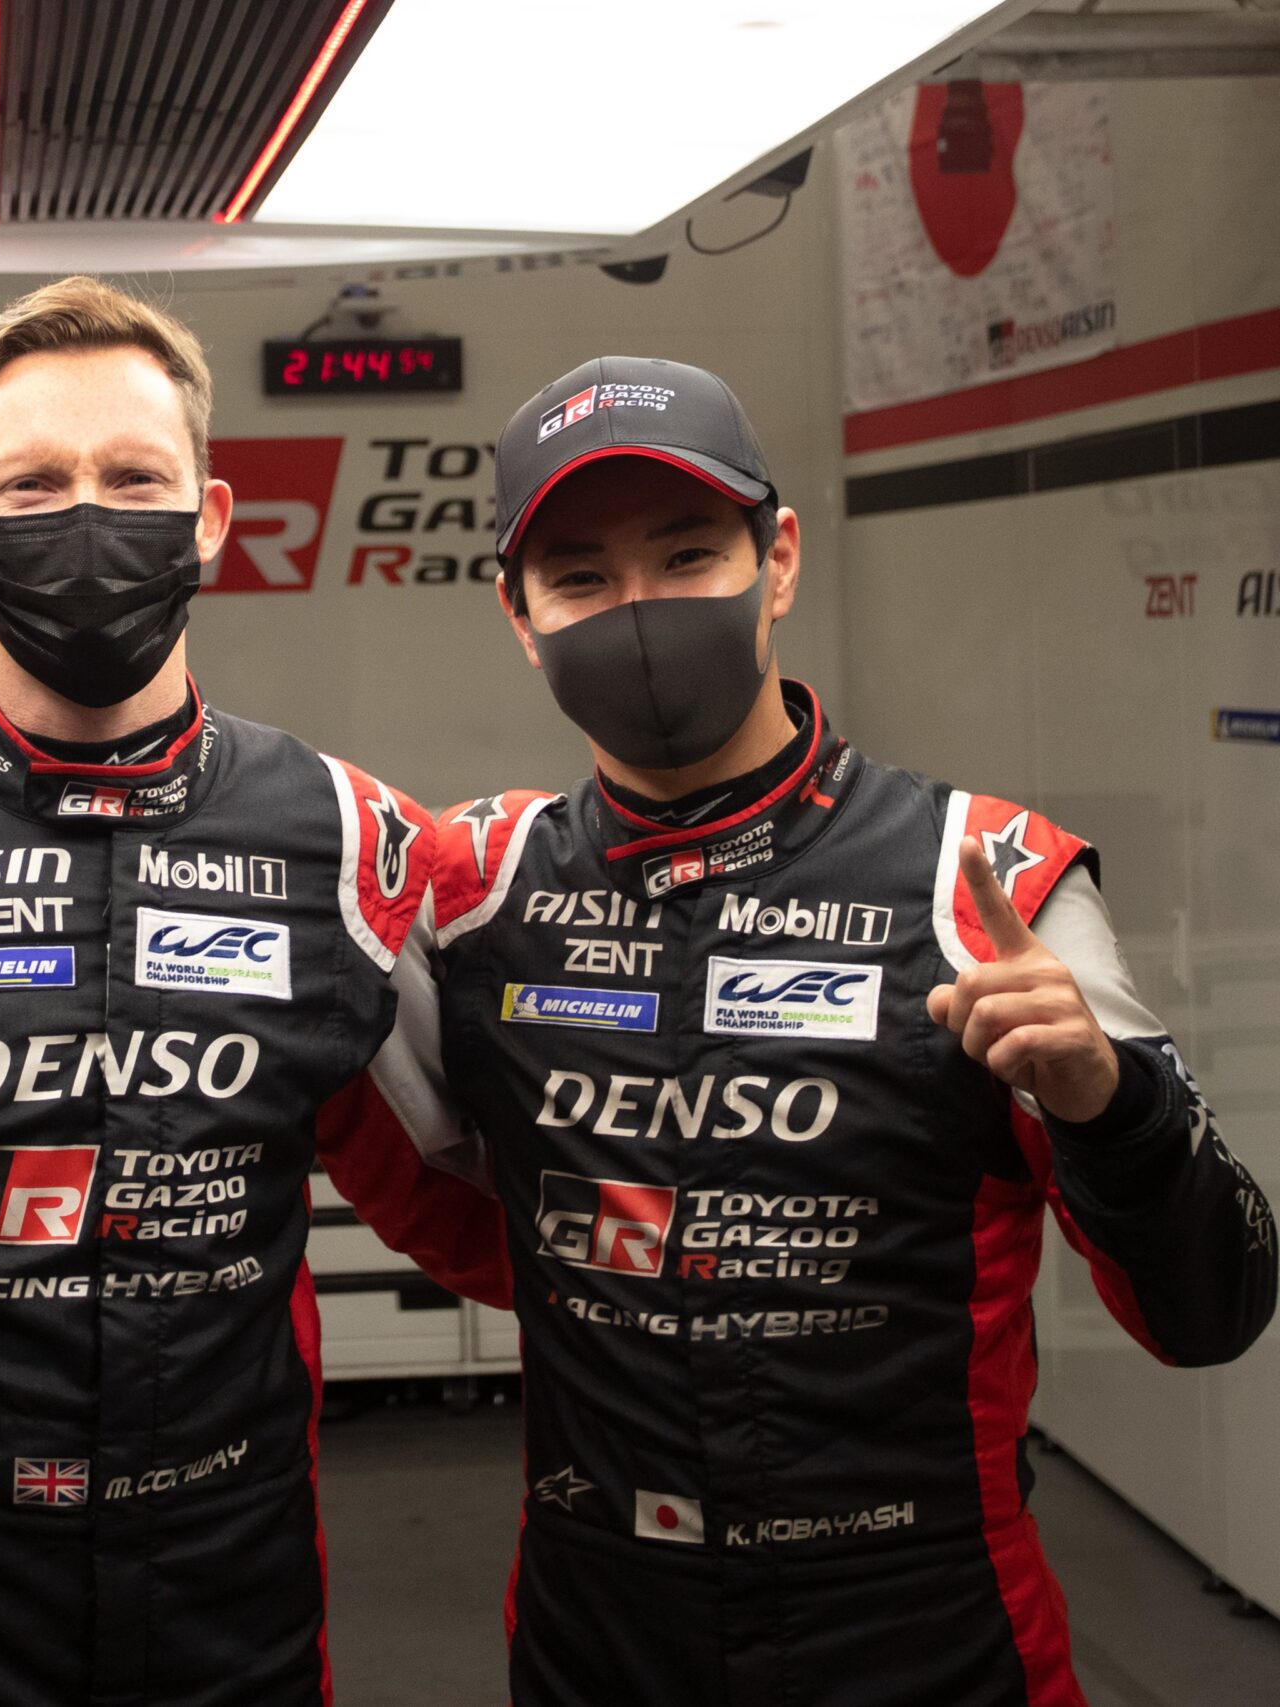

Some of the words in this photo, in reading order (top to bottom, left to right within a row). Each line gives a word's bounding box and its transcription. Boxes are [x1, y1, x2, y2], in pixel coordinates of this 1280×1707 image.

[598, 399, 667, 411] Racing
[601, 383, 675, 397] TOYOTA
[539, 399, 590, 438] GR
[600, 391, 668, 402] GAZOO
[358, 493, 497, 533] GA
[346, 545, 499, 585] Rac
[1144, 572, 1198, 618] ZENT
[1237, 570, 1280, 618] AI
[136, 774, 188, 798] TOYOTA
[129, 801, 186, 816] Racing
[706, 820, 774, 854] TOYOTA
[137, 844, 244, 894] Mobil
[648, 861, 701, 895] GR
[709, 835, 772, 865] GAZOO
[709, 848, 774, 875] Racing
[718, 893, 841, 941] Mobil
[148, 925, 280, 963] WEC
[564, 938, 663, 977] ZENT
[146, 961, 163, 972] FIA
[166, 963, 205, 974] WORLD
[207, 967, 273, 980] ENDURANCE
[146, 971, 229, 986] CHAMPIONSHIP
[718, 970, 870, 1006] WEC
[541, 998, 642, 1019] MICHELIN
[716, 1018, 804, 1030] CHAMPIONSHIP
[717, 1008, 735, 1018] FIA
[737, 1010, 779, 1020] WORLD
[781, 1011, 853, 1023] ENDURANCE
[535, 1069, 839, 1142] DENSO
[113, 1142, 264, 1177] TOYOTA
[105, 1175, 246, 1209] GAZOO
[687, 1190, 879, 1218] TOYOTA
[97, 1208, 248, 1240] Racing
[537, 1210, 661, 1274] GR
[681, 1221, 860, 1249] GAZOO
[102, 1256, 264, 1298] HYBRID
[678, 1251, 852, 1285] Racing
[548, 1290, 679, 1337] ACING
[689, 1304, 889, 1342] HYBRID
[726, 1524, 750, 1546] K.
[756, 1501, 914, 1543] KOBAYASHI
